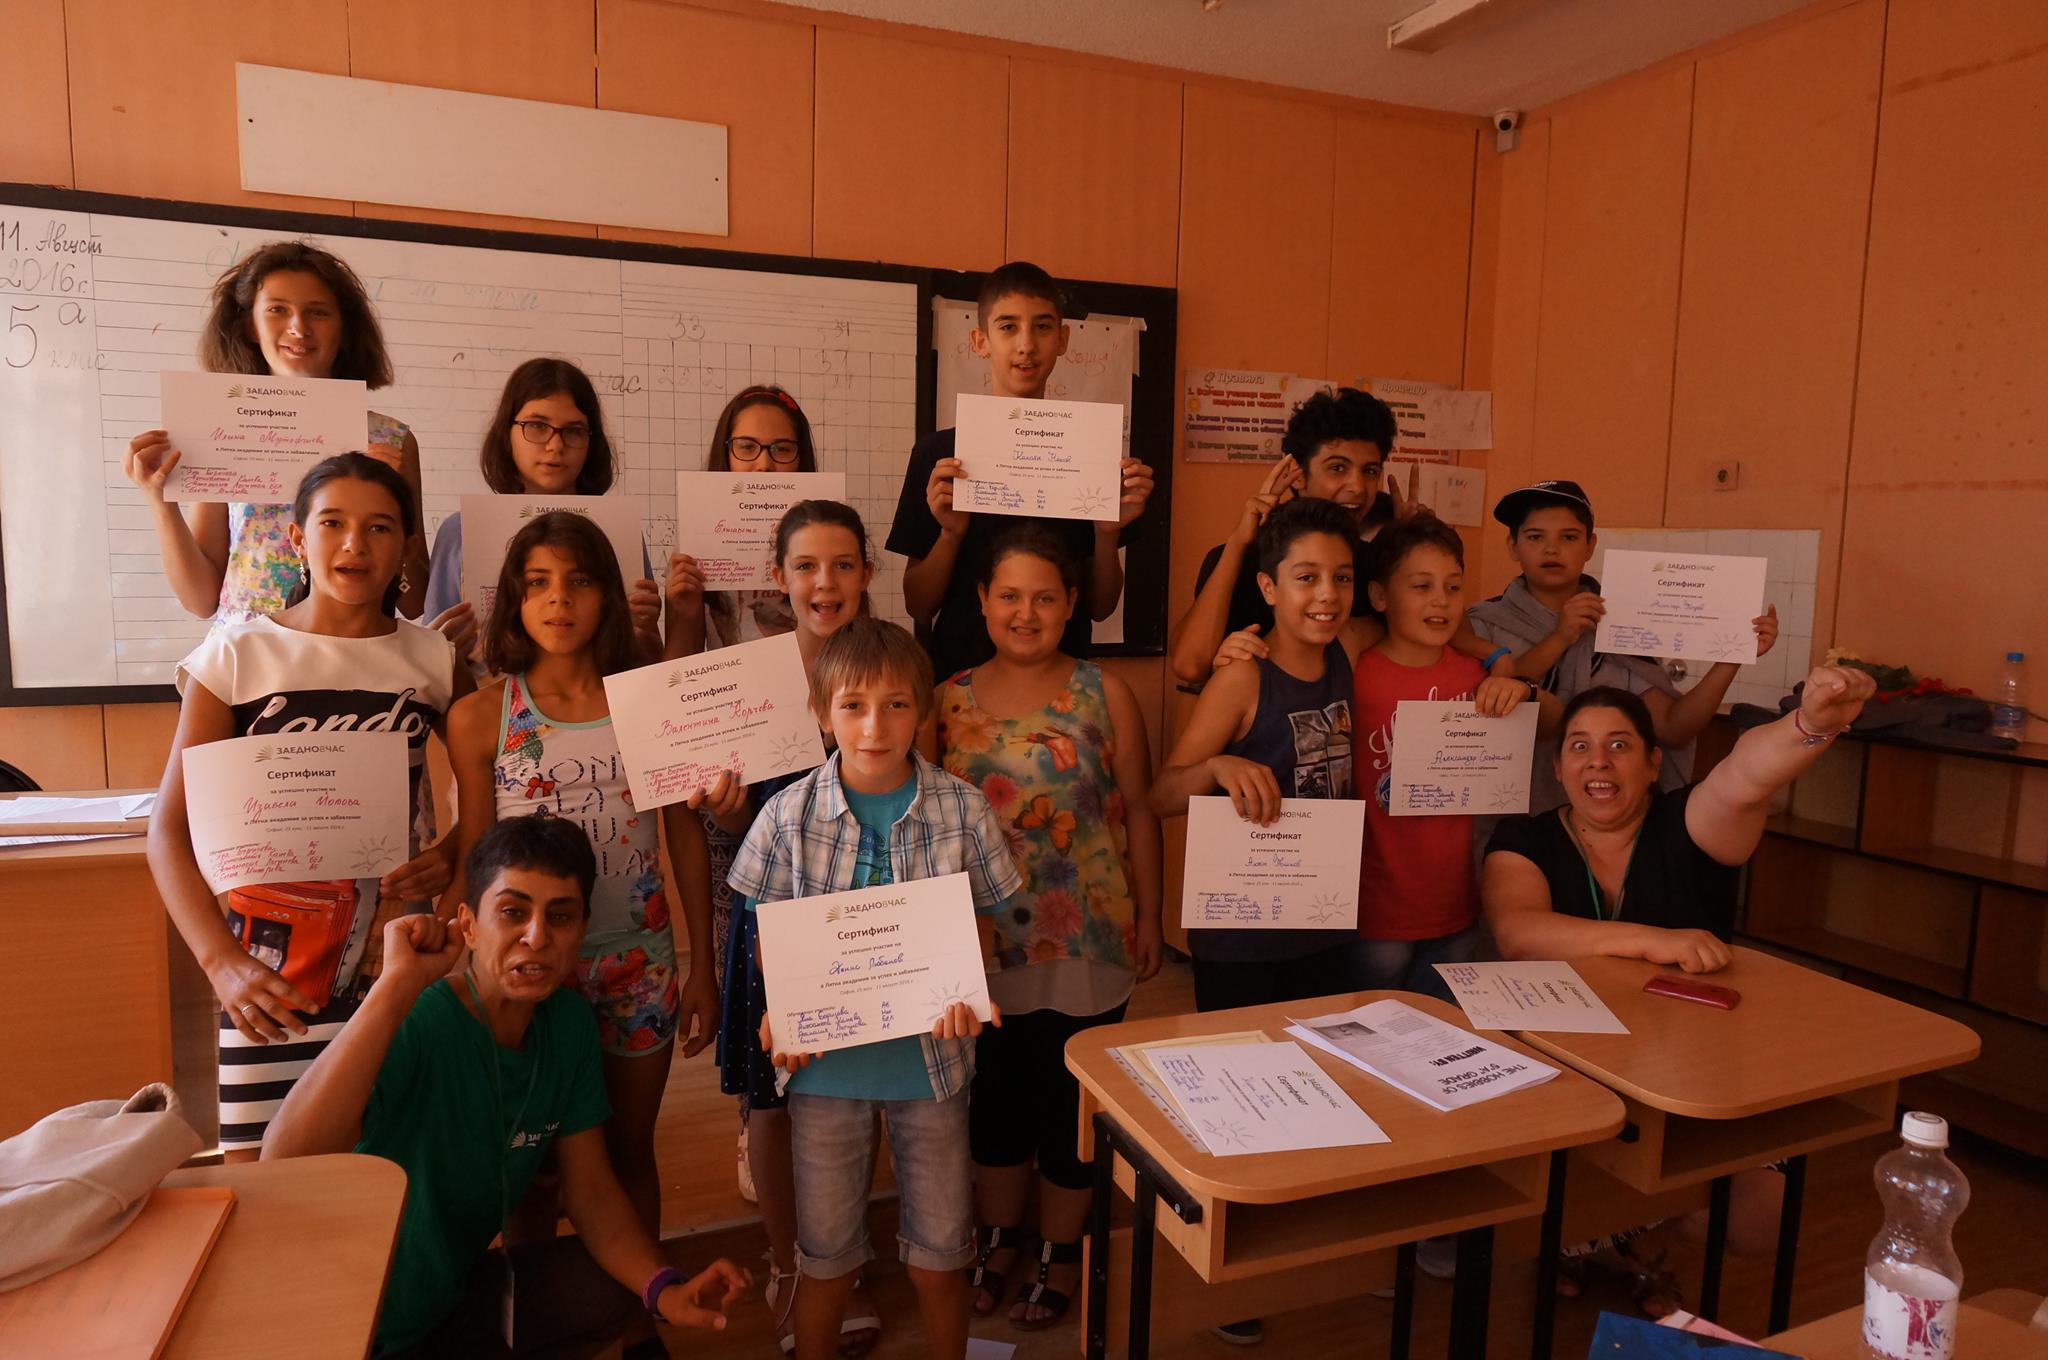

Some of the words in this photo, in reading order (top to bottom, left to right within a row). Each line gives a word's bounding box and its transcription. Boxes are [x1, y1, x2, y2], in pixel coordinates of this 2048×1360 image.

[5, 304, 39, 368] 5
[237, 407, 297, 418] Сертификат
[1015, 428, 1064, 438] Сертификат
[739, 502, 788, 511] Сертификат
[1658, 579, 1705, 588] Сертификат
[684, 658, 742, 678] ЗАЕДНОВЧАС
[680, 682, 738, 703] Сертификат
[277, 745, 345, 755] ЗАЕДНОВЧАС
[267, 769, 336, 781] Сертификат
[1250, 831, 1302, 840] Сертификат
[844, 898, 907, 914] ЗАЕДНОВЧАС
[837, 924, 900, 941] Сертификат
[1501, 1064, 1527, 1075] THE
